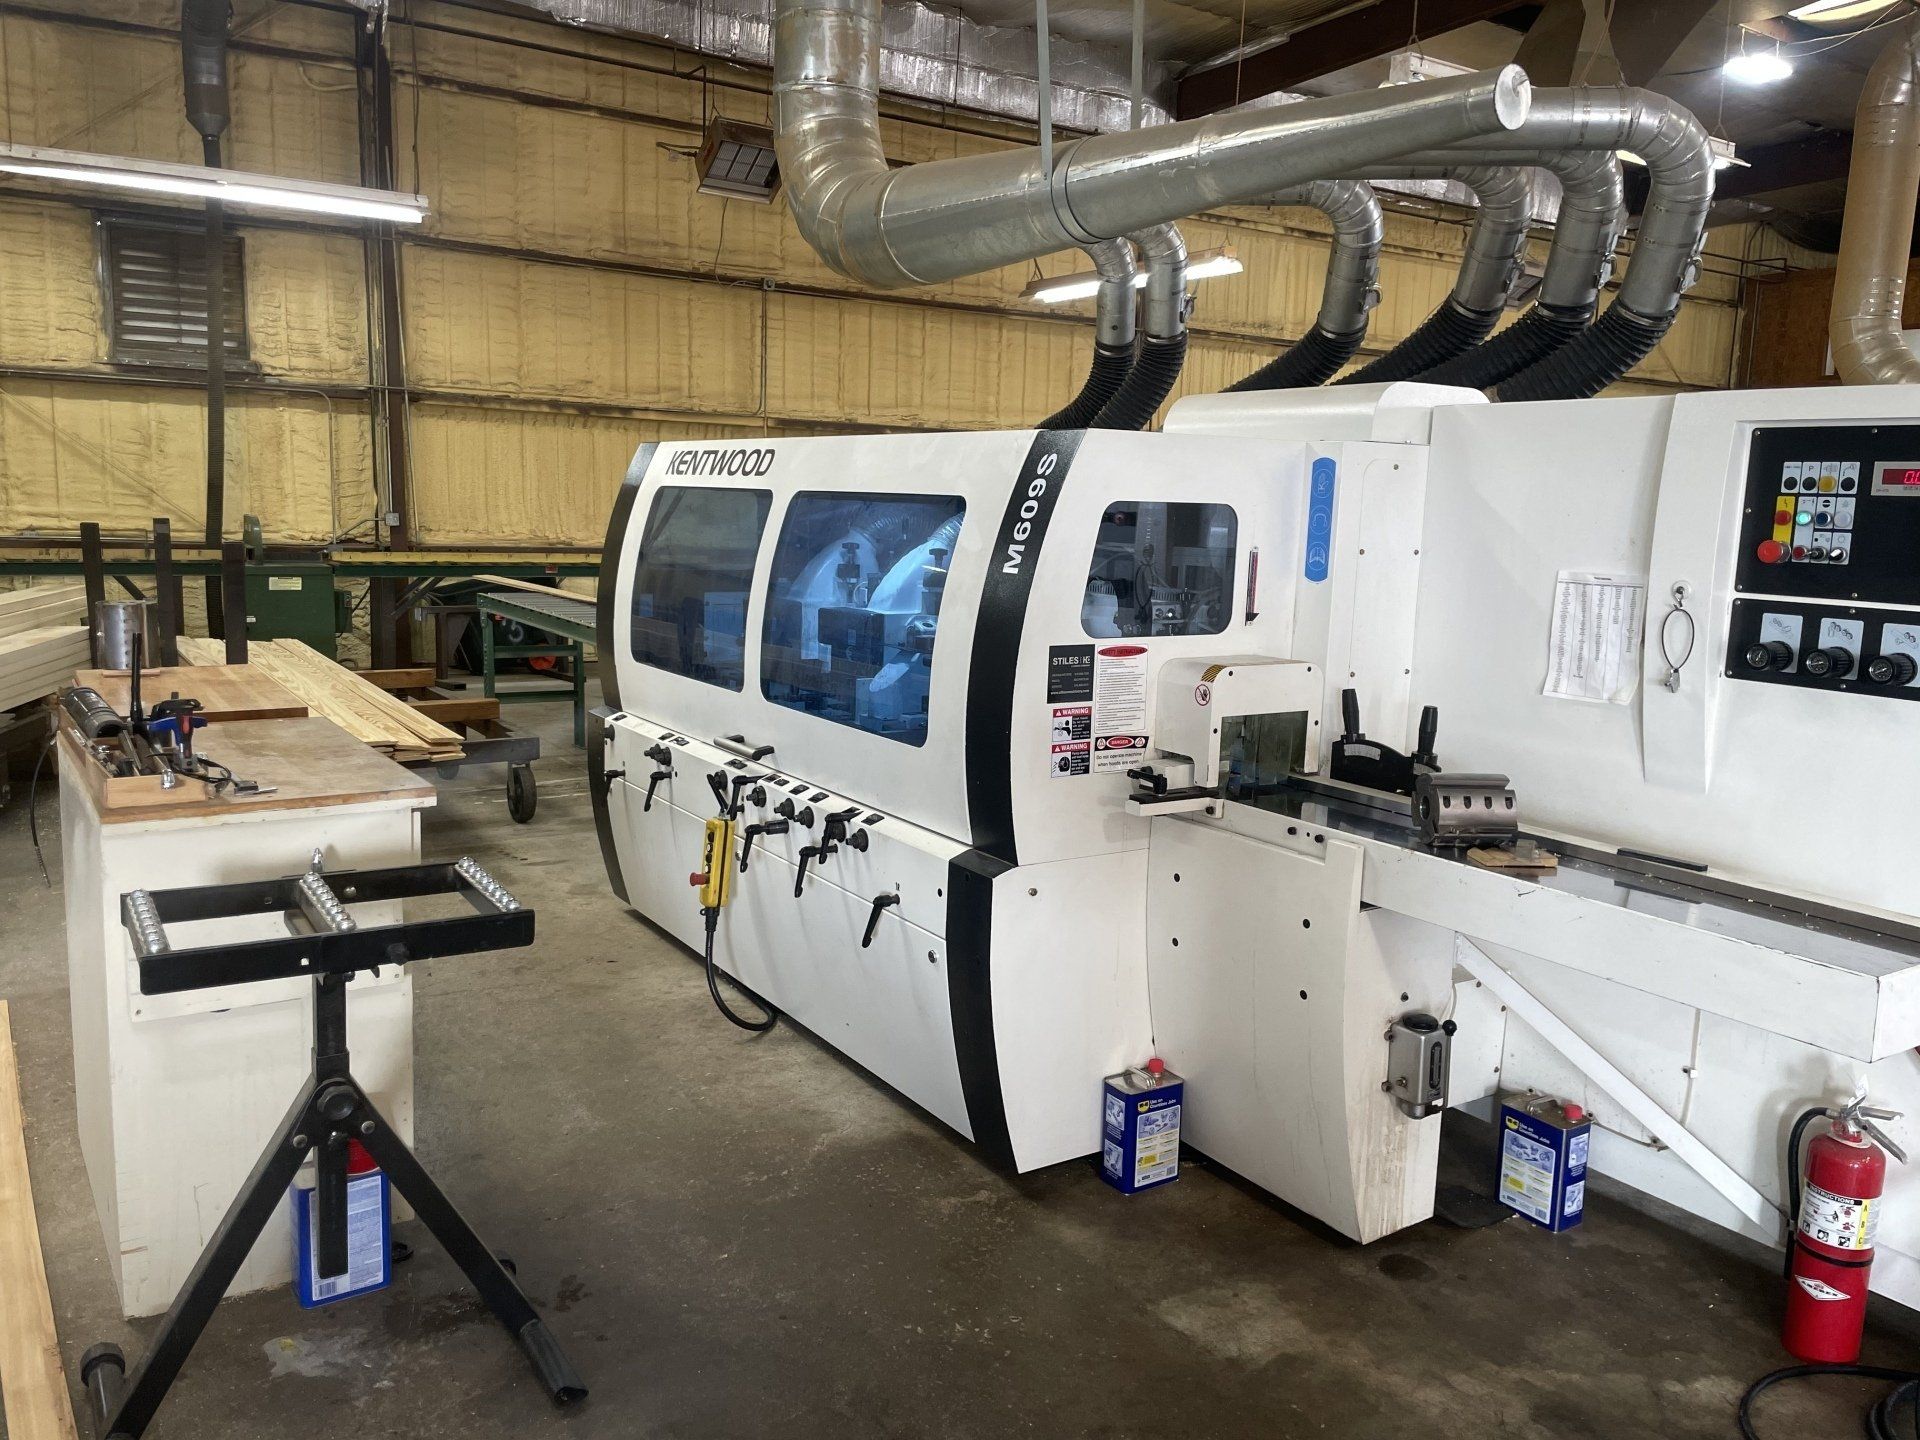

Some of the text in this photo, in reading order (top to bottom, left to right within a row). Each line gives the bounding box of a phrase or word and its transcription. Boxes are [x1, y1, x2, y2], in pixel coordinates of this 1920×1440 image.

[665, 449, 776, 476] KENTWOOD
[1002, 453, 1058, 574] M609S
[1052, 656, 1079, 666] STILES
[1062, 707, 1089, 716] WARNING
[1061, 743, 1088, 751] WARNING
[1809, 1185, 1855, 1206] INSTRUCTIONS
